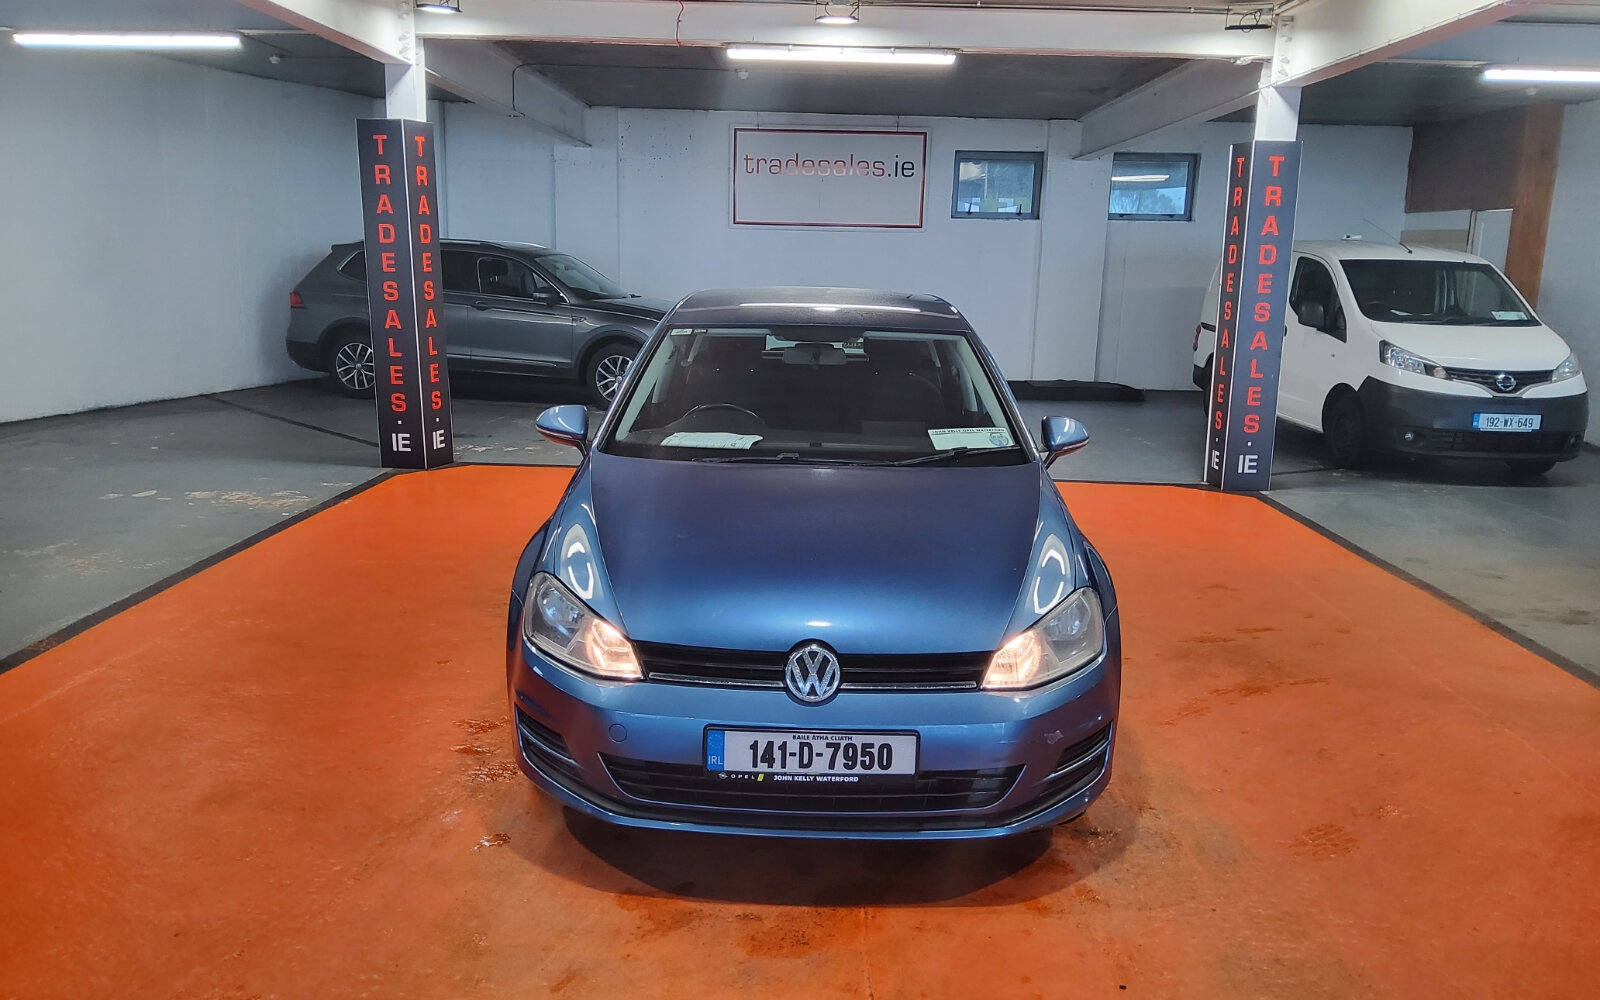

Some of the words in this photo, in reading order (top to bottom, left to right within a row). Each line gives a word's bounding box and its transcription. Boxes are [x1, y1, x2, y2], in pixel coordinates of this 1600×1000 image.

[744, 153, 915, 178] tradesales.ie
[1486, 416, 1534, 428] 192-WX-649
[708, 755, 724, 765] IRL
[749, 740, 893, 771] 141-D-7950
